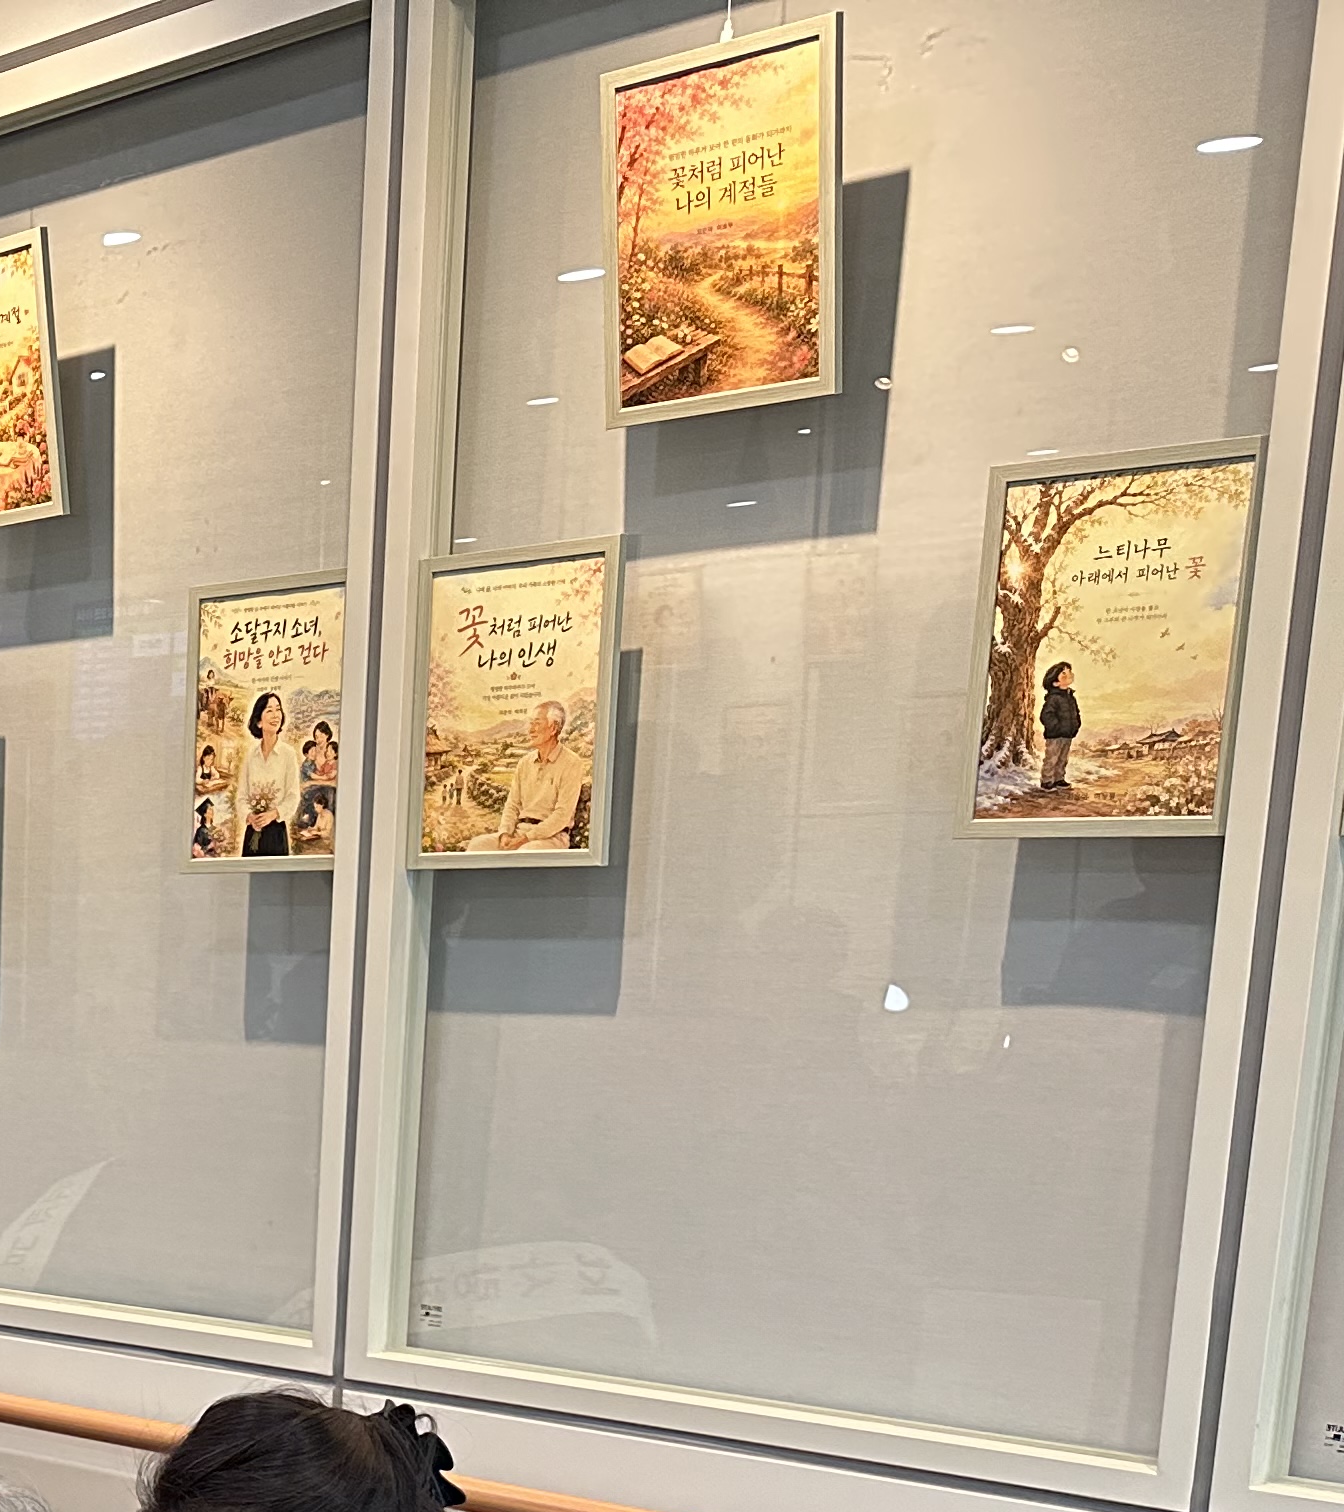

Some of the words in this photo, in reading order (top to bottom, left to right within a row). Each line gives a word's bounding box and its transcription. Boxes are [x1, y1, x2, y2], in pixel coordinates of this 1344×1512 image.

[668, 157, 722, 191] 꽃처럼
[730, 142, 786, 175] 피어난
[676, 186, 711, 215] 나의
[719, 173, 778, 205] 계절들
[0, 306, 22, 325] 계절
[1093, 537, 1172, 561] 느티나무
[1071, 567, 1129, 587] 아래에서
[1136, 562, 1180, 582] 피어난
[1185, 555, 1207, 580] 꽃
[230, 618, 287, 645] 소달구지
[291, 615, 322, 639] 소녀,
[457, 604, 522, 658] 꽃처럼
[527, 611, 573, 634] 피어난
[223, 647, 265, 671] 희망을
[268, 644, 295, 667] 안고
[297, 641, 330, 666] 걷다
[477, 648, 513, 671] 나의
[517, 638, 557, 668] 인생
